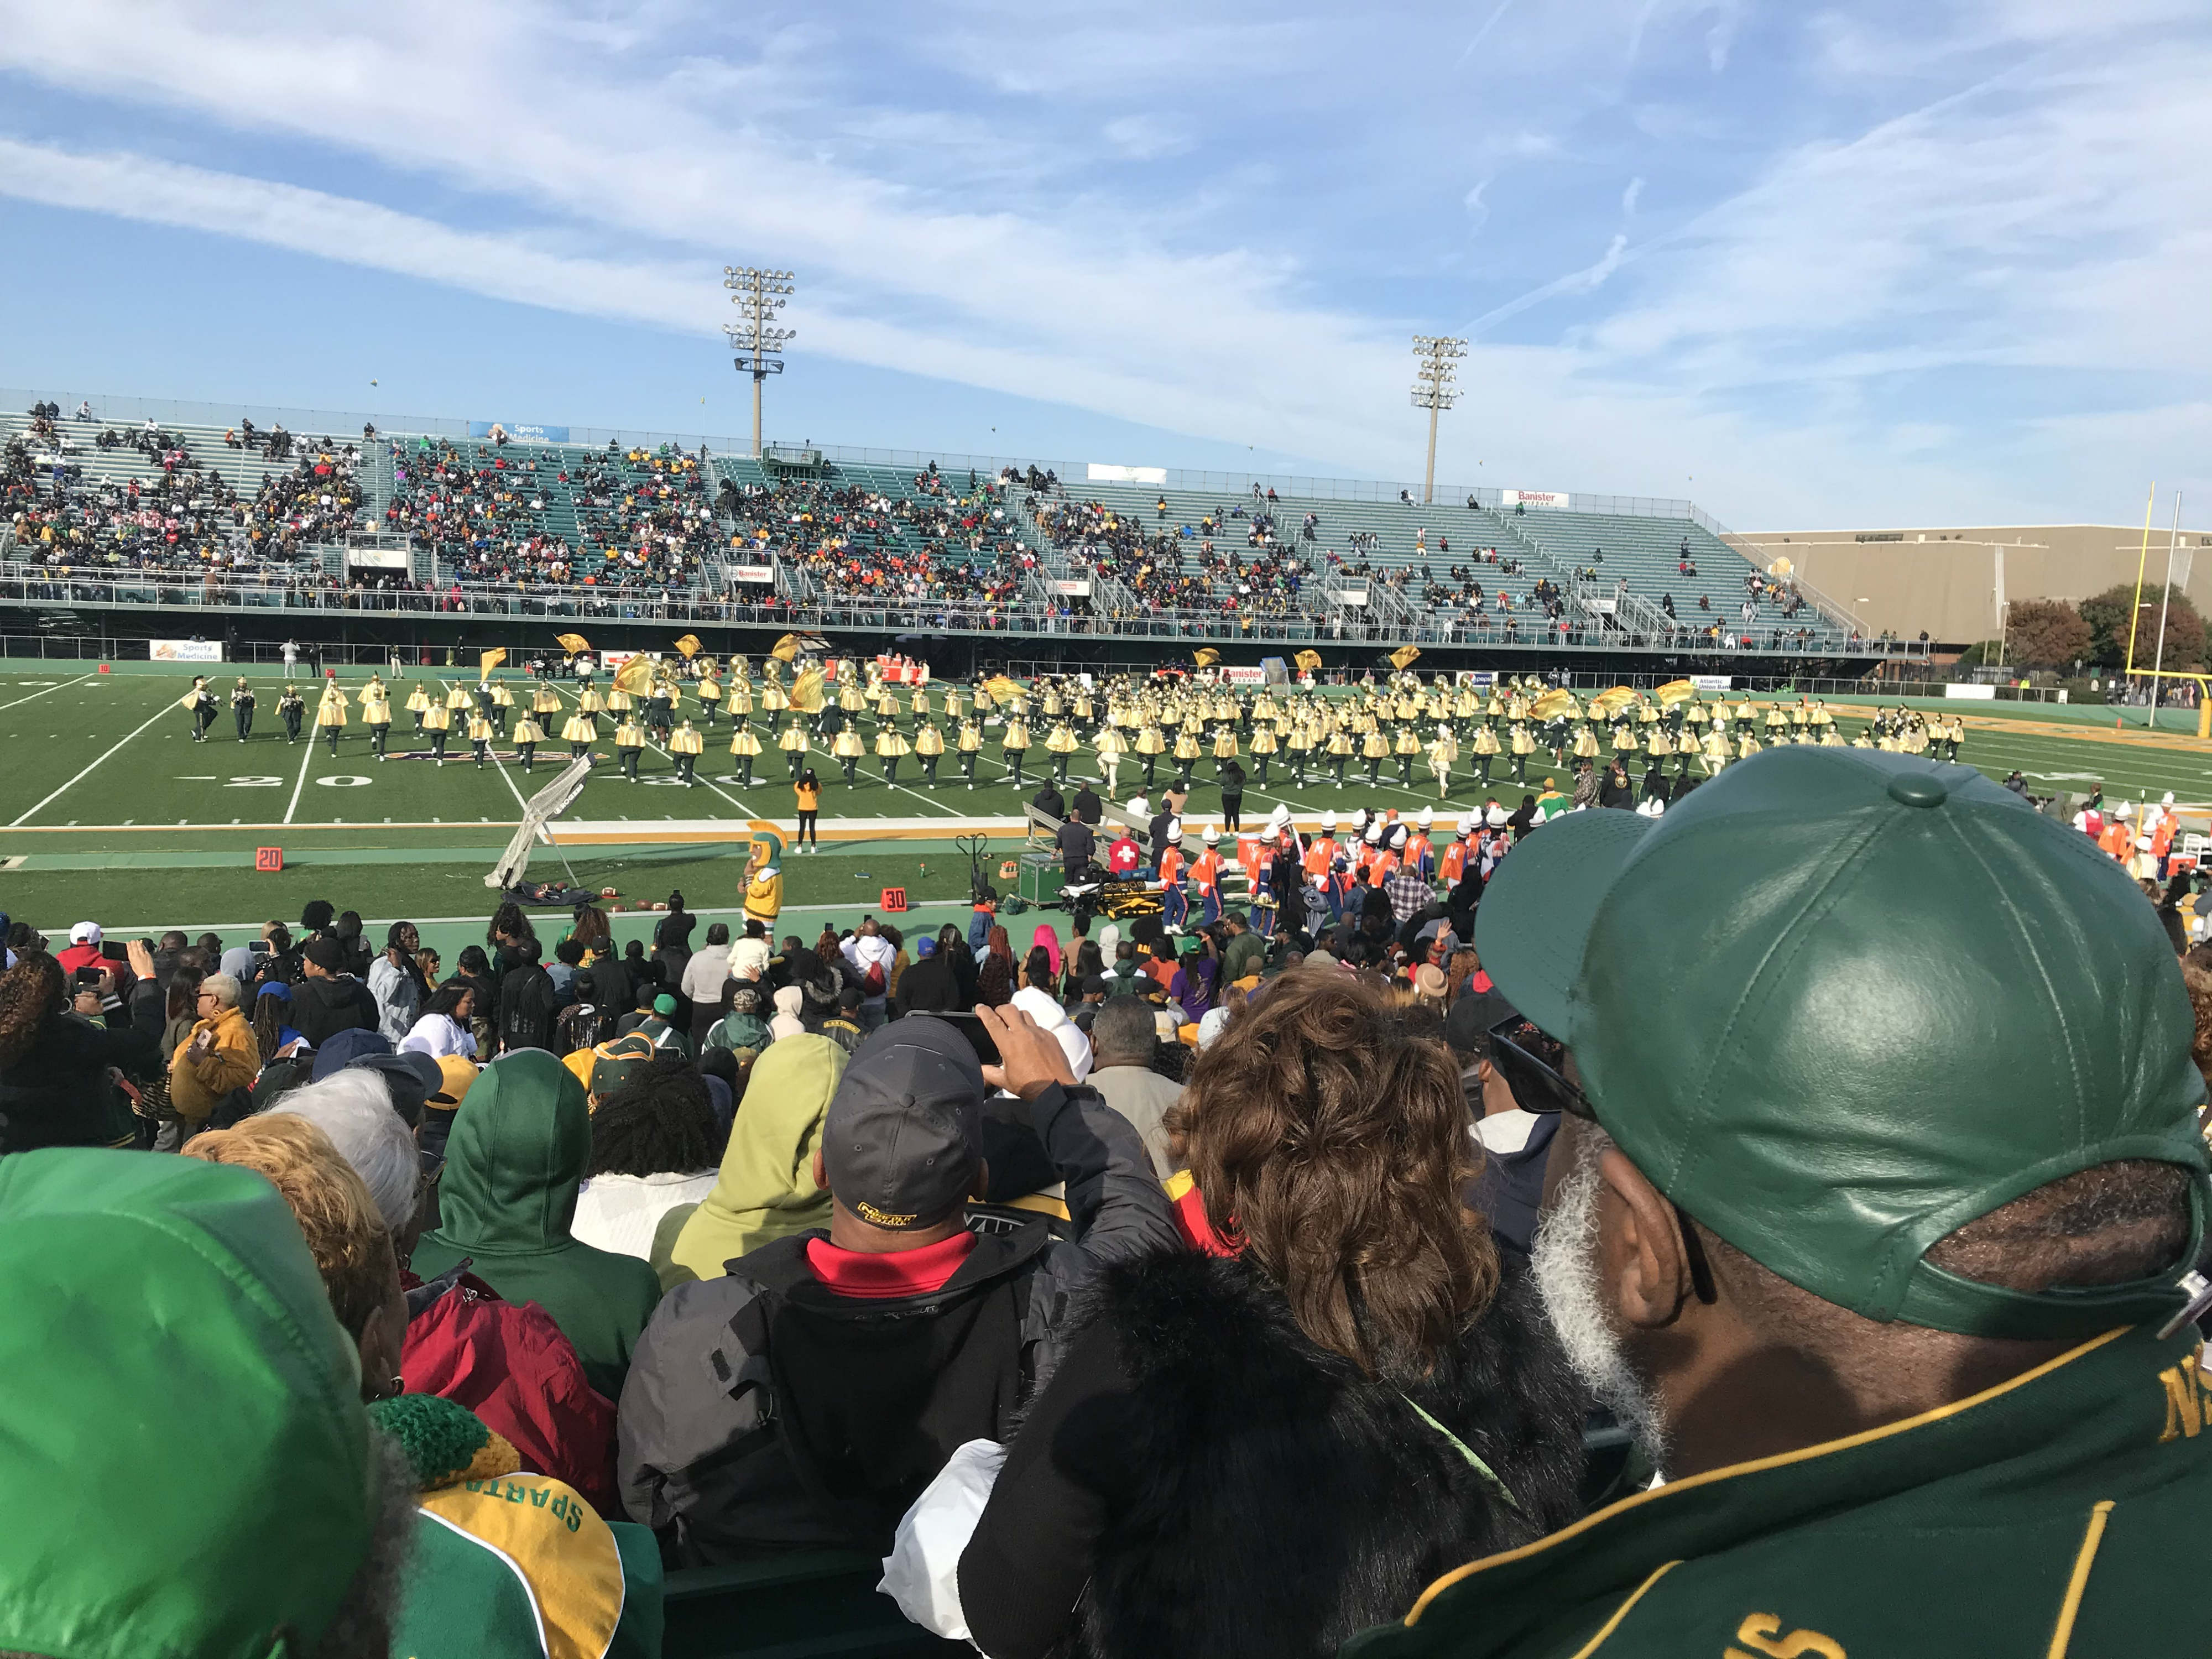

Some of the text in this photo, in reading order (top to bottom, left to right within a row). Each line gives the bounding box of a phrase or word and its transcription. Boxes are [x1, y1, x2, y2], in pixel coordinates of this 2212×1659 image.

[514, 424, 544, 434] Sports
[509, 433, 549, 442] Medicine
[1518, 491, 1556, 502] Banister
[1314, 841, 1326, 854] M
[1410, 837, 1421, 850] M
[259, 850, 279, 868] 20
[1448, 846, 1459, 859] M
[886, 890, 905, 909] 30
